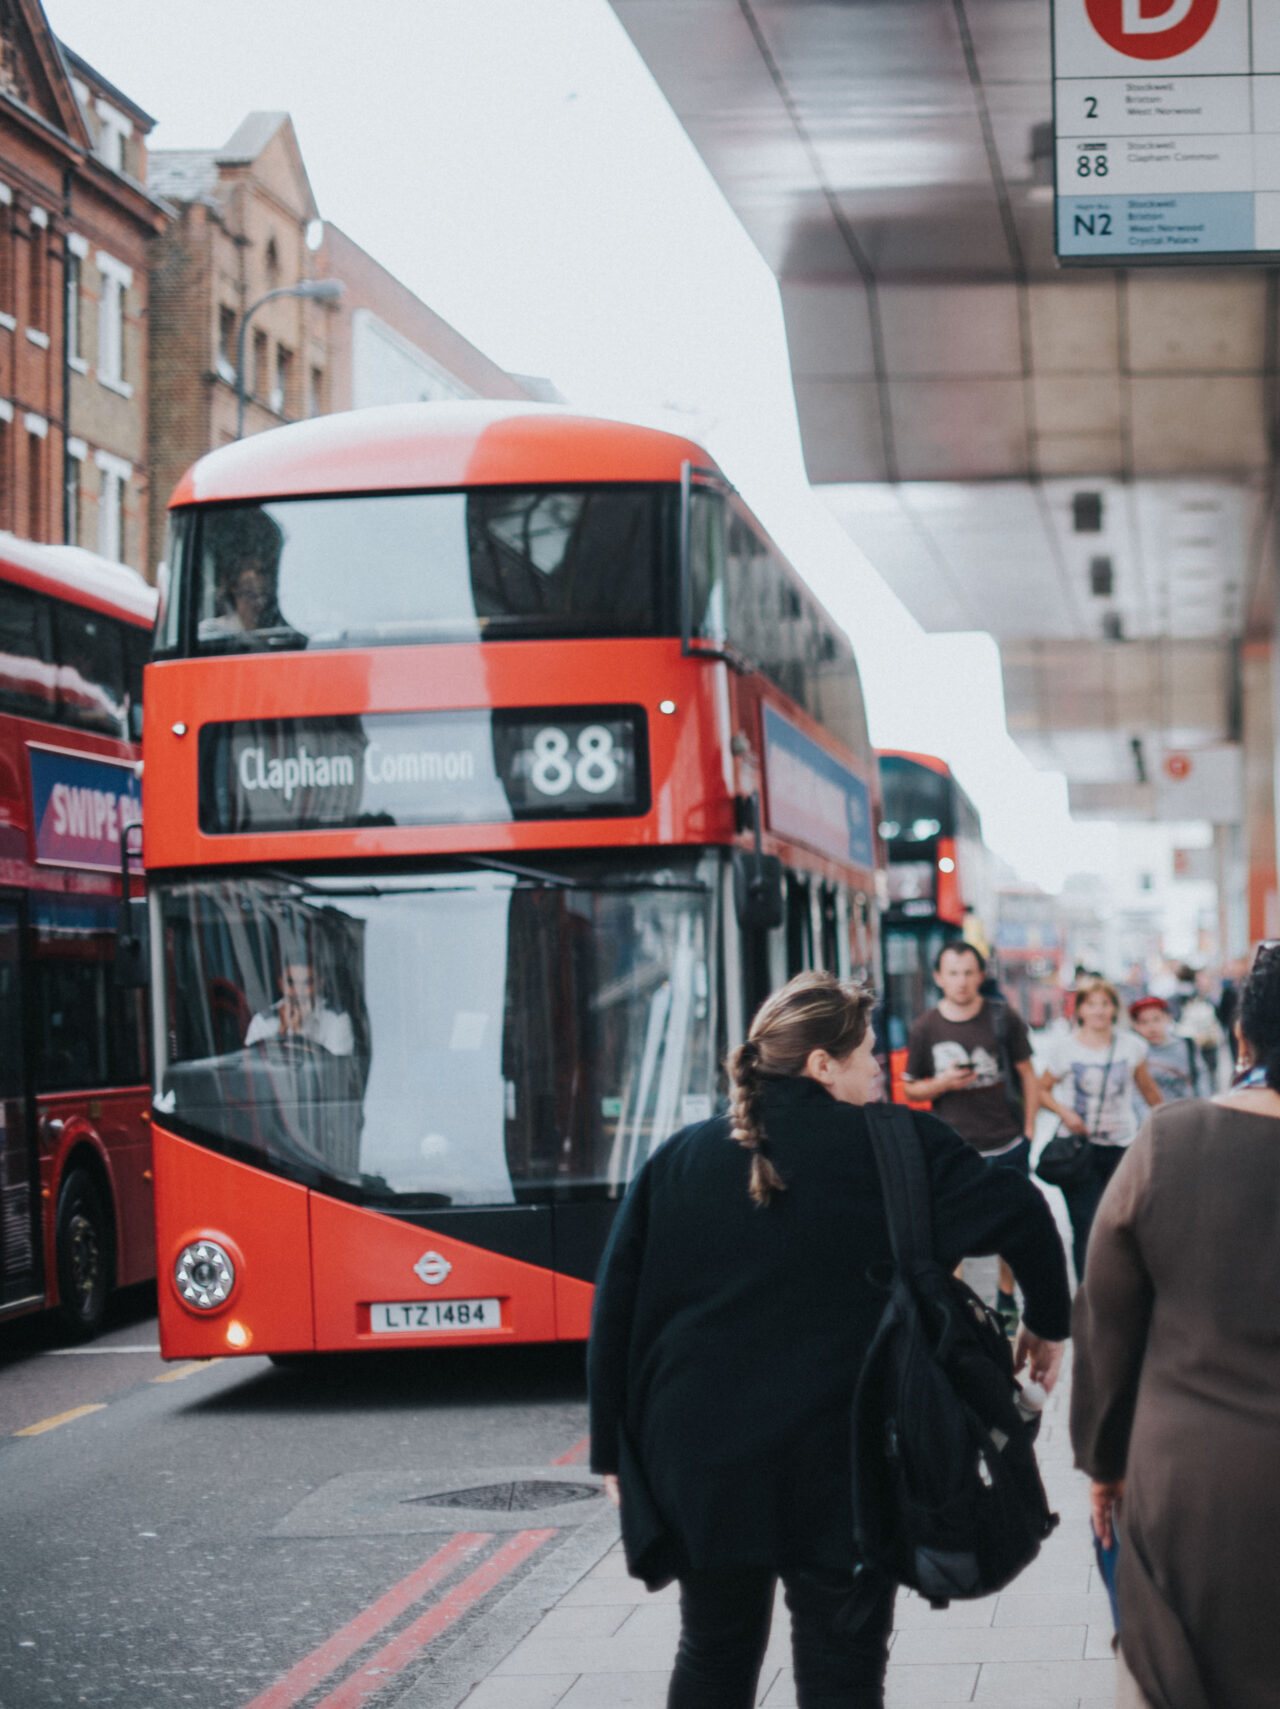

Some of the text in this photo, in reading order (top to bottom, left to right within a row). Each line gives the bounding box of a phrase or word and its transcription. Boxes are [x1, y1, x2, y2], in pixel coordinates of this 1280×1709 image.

[1084, 96, 1099, 119] 2
[1077, 155, 1109, 177] 88
[1073, 213, 1112, 236] N2
[239, 741, 474, 800] Clapham Common
[531, 724, 619, 796] 88
[52, 782, 119, 843] SWIPE
[385, 1303, 485, 1328] LTZ 1484
